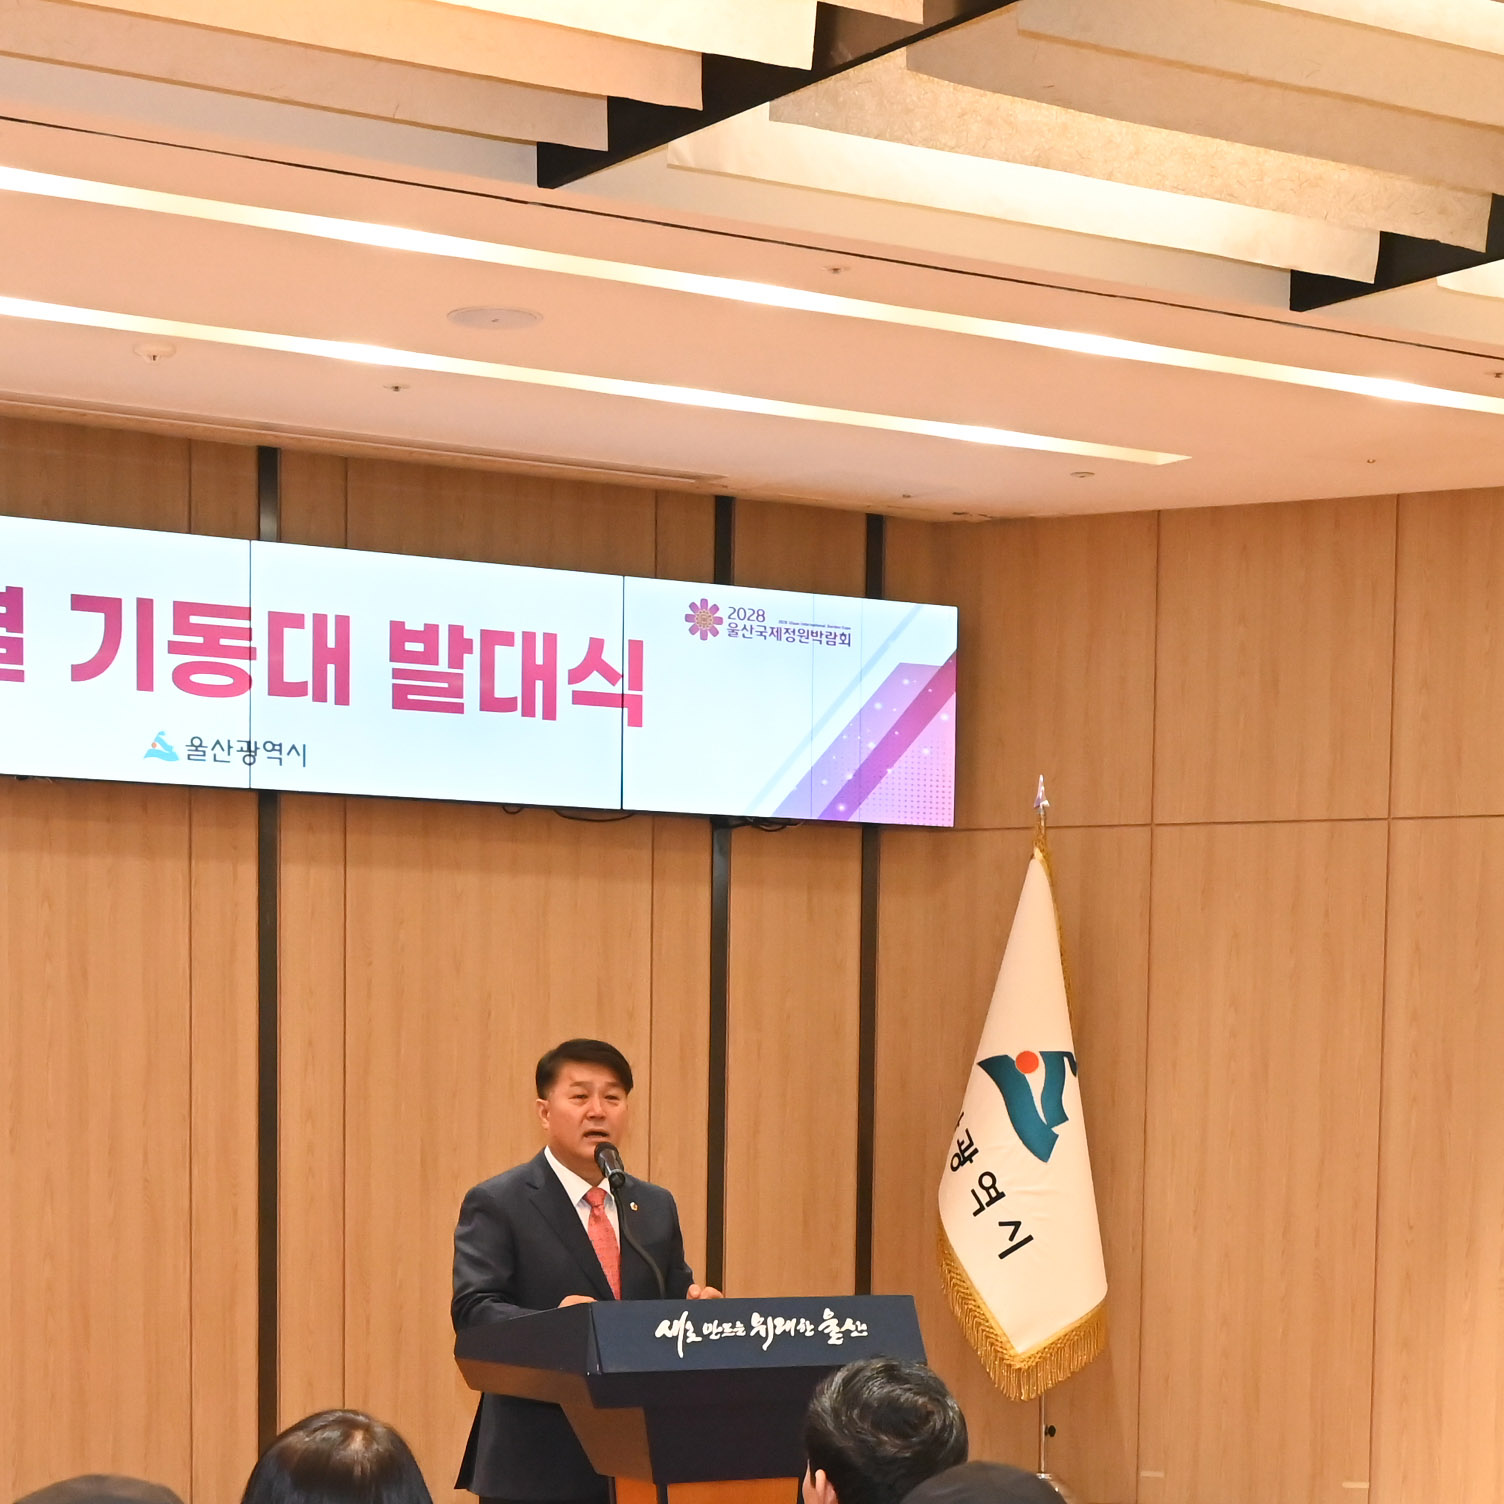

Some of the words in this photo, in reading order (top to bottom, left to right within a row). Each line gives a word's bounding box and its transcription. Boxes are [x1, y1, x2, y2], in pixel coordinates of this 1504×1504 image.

[727, 606, 766, 623] 2028
[727, 622, 852, 648] 울산국제정원박람회
[70, 593, 351, 707] 기동대
[389, 619, 644, 728] 발대식
[184, 735, 308, 768] 울산광역시
[655, 1310, 703, 1359] 새로
[702, 1320, 747, 1340] 만드는
[749, 1311, 815, 1351] 위대한
[818, 1307, 869, 1345] 울산
